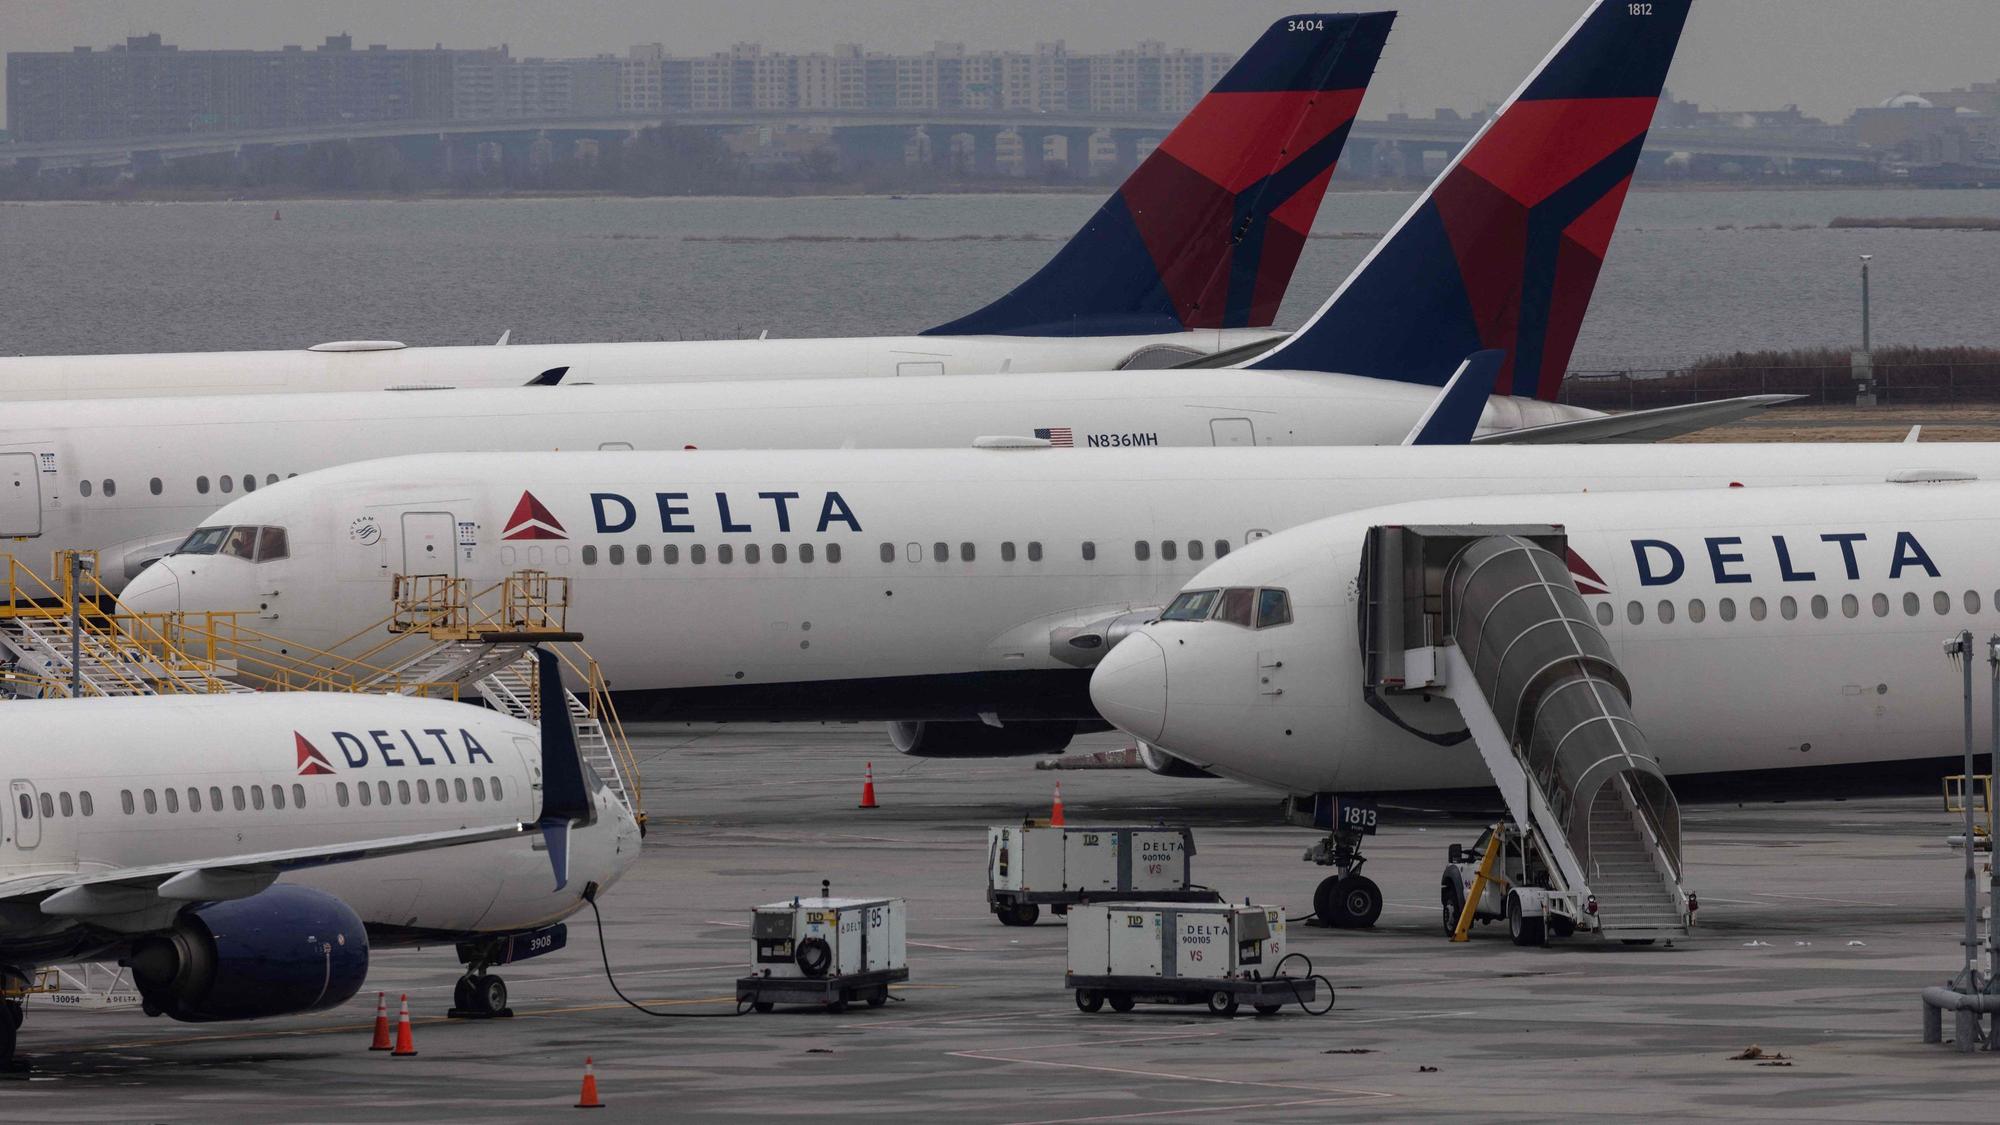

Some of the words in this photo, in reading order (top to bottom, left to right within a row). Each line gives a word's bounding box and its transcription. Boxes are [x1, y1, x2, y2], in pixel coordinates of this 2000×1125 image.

[1628, 4, 1652, 15] 1812
[1287, 19, 1323, 31] 3404
[1087, 433, 1158, 447] N836MH
[590, 491, 864, 534] DELTA
[350, 516, 374, 540] KYTEAM
[1630, 531, 1942, 586] DELTA
[331, 728, 493, 768] DELTA
[1344, 806, 1377, 827] 1813
[1083, 834, 1099, 846] TLD
[1143, 842, 1184, 851] DELTA
[1142, 854, 1171, 862] 900106
[1149, 864, 1162, 874] VS
[806, 912, 824, 924] TLD
[871, 908, 882, 928] 95
[1127, 915, 1143, 927] TLD
[1187, 925, 1229, 935] DELTA
[1182, 936, 1211, 944] 900105
[1270, 942, 1279, 954] VS
[1190, 950, 1203, 961] VS
